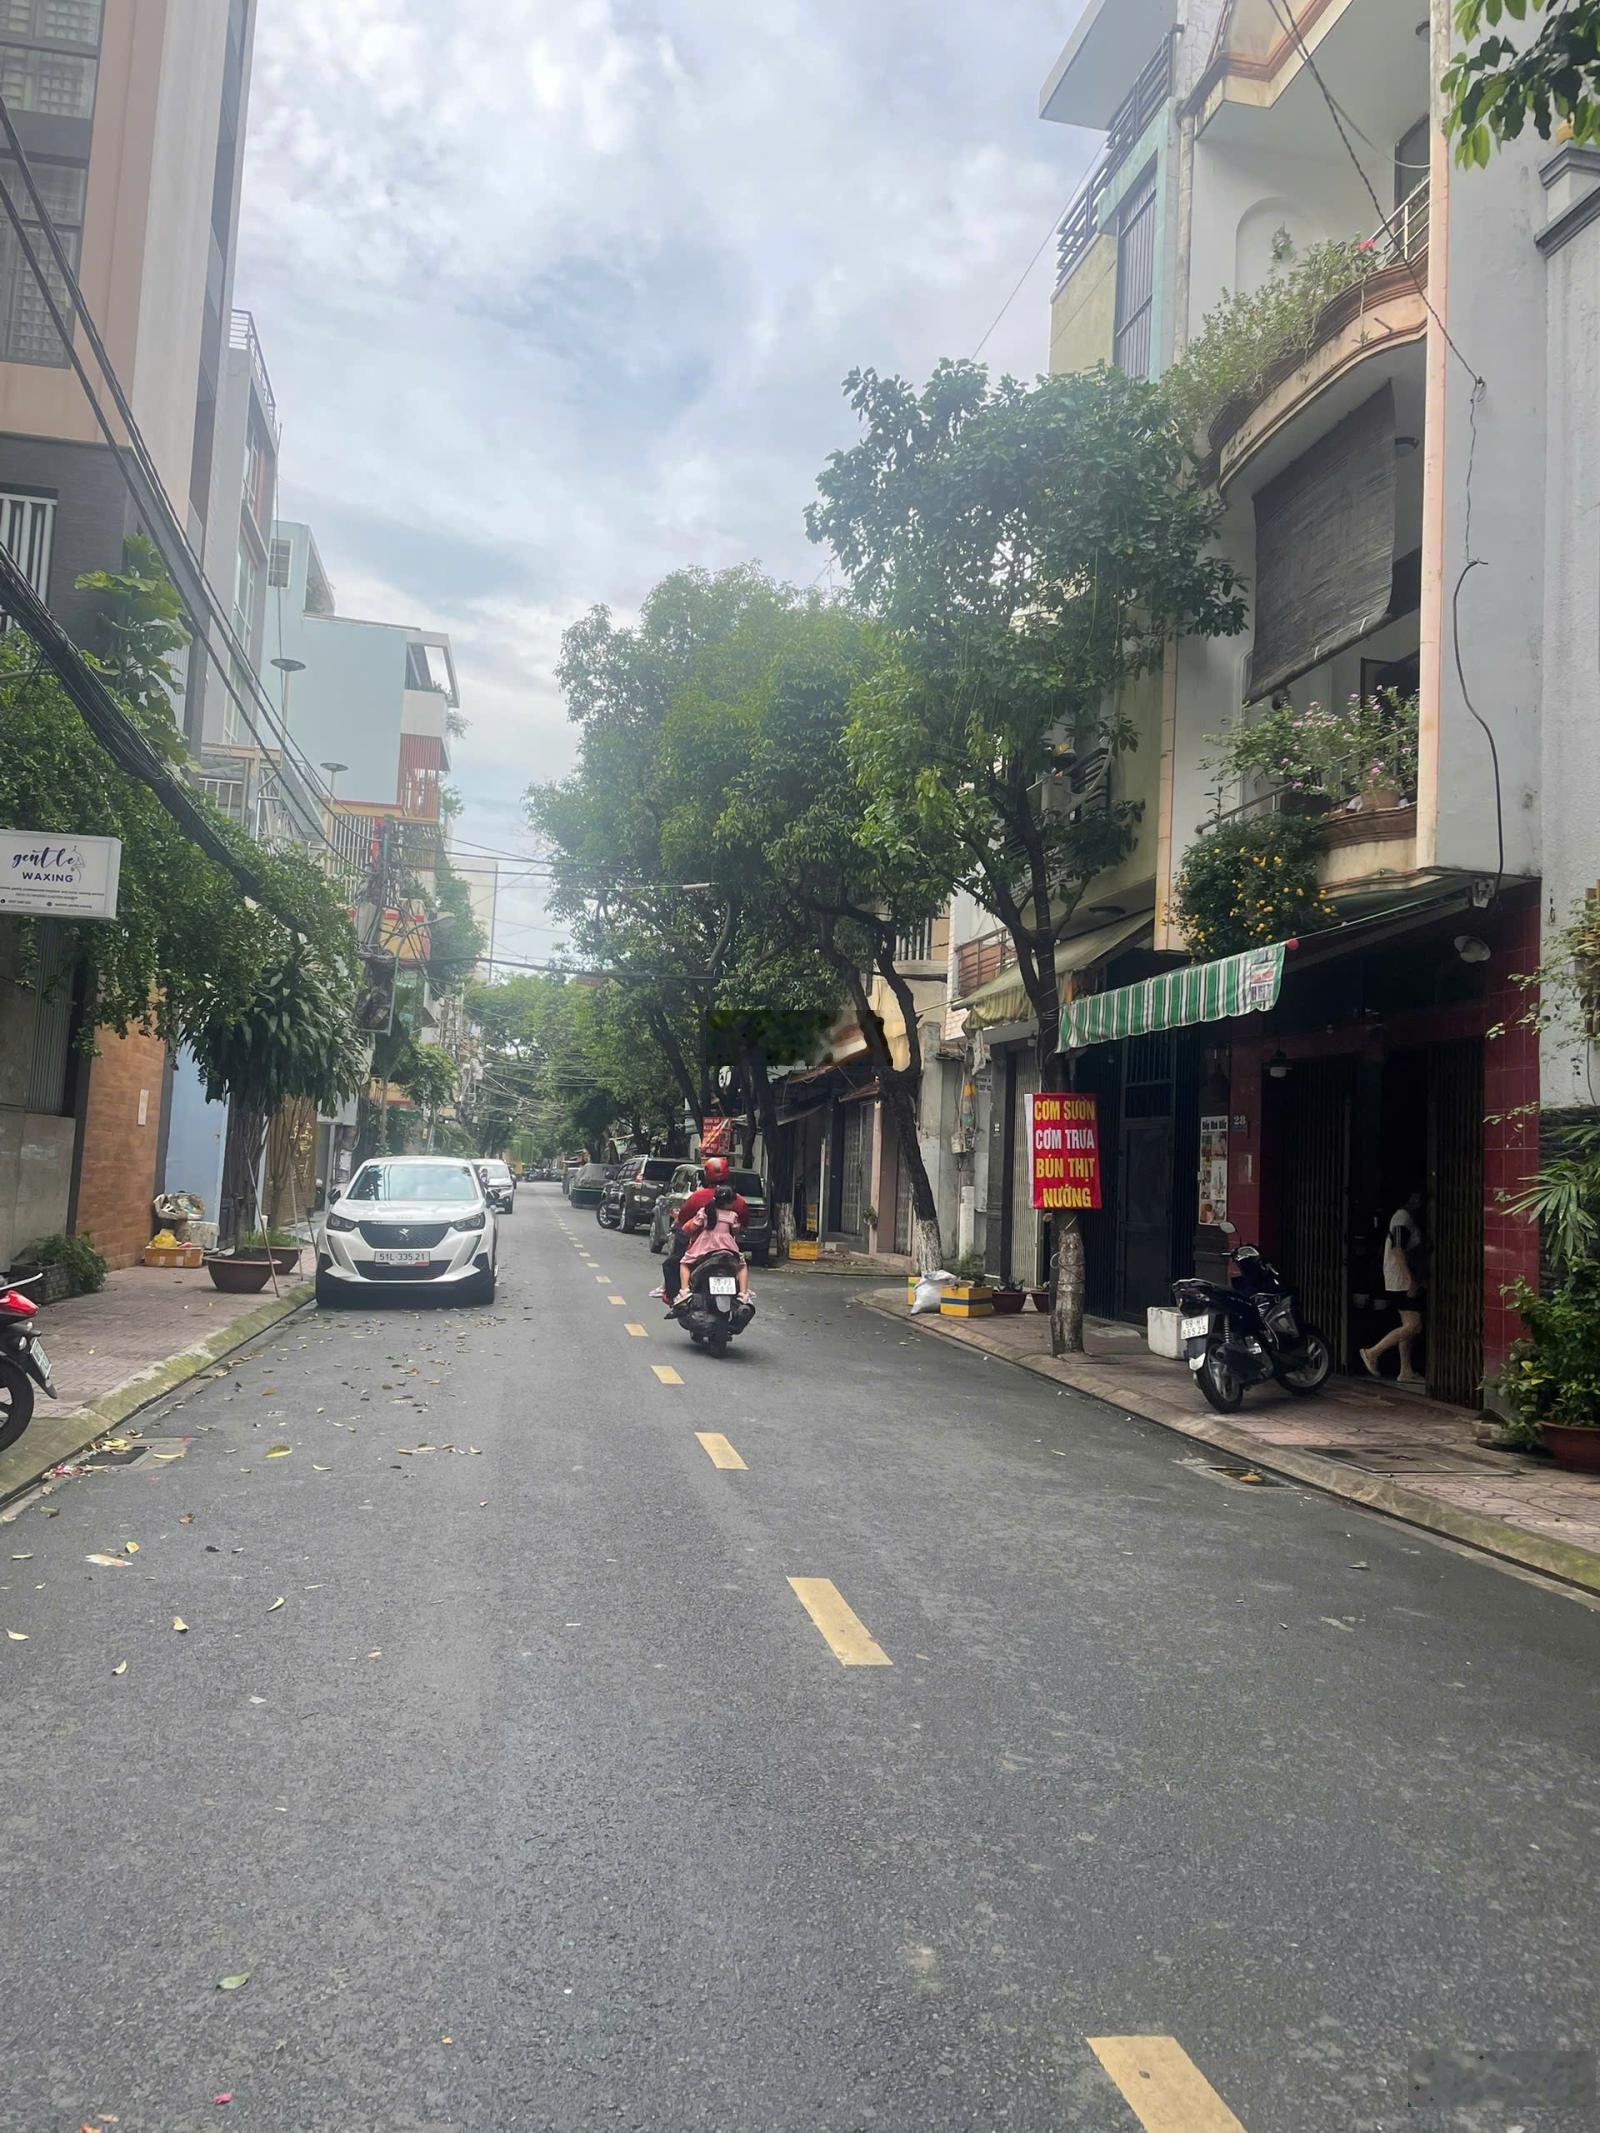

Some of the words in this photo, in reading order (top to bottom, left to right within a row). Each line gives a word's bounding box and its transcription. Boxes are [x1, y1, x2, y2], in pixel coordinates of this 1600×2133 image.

[12, 846, 74, 869] gentle
[22, 871, 74, 883] WAXING
[1034, 1099, 1061, 1121] CƠM
[1233, 1115, 1246, 1125] 28
[1035, 1127, 1062, 1150] CƠM
[1065, 1127, 1095, 1150] TRƯA
[1036, 1154, 1064, 1179] BÚN
[1068, 1158, 1096, 1182] THỊT
[1042, 1184, 1092, 1209] NƯỚNG
